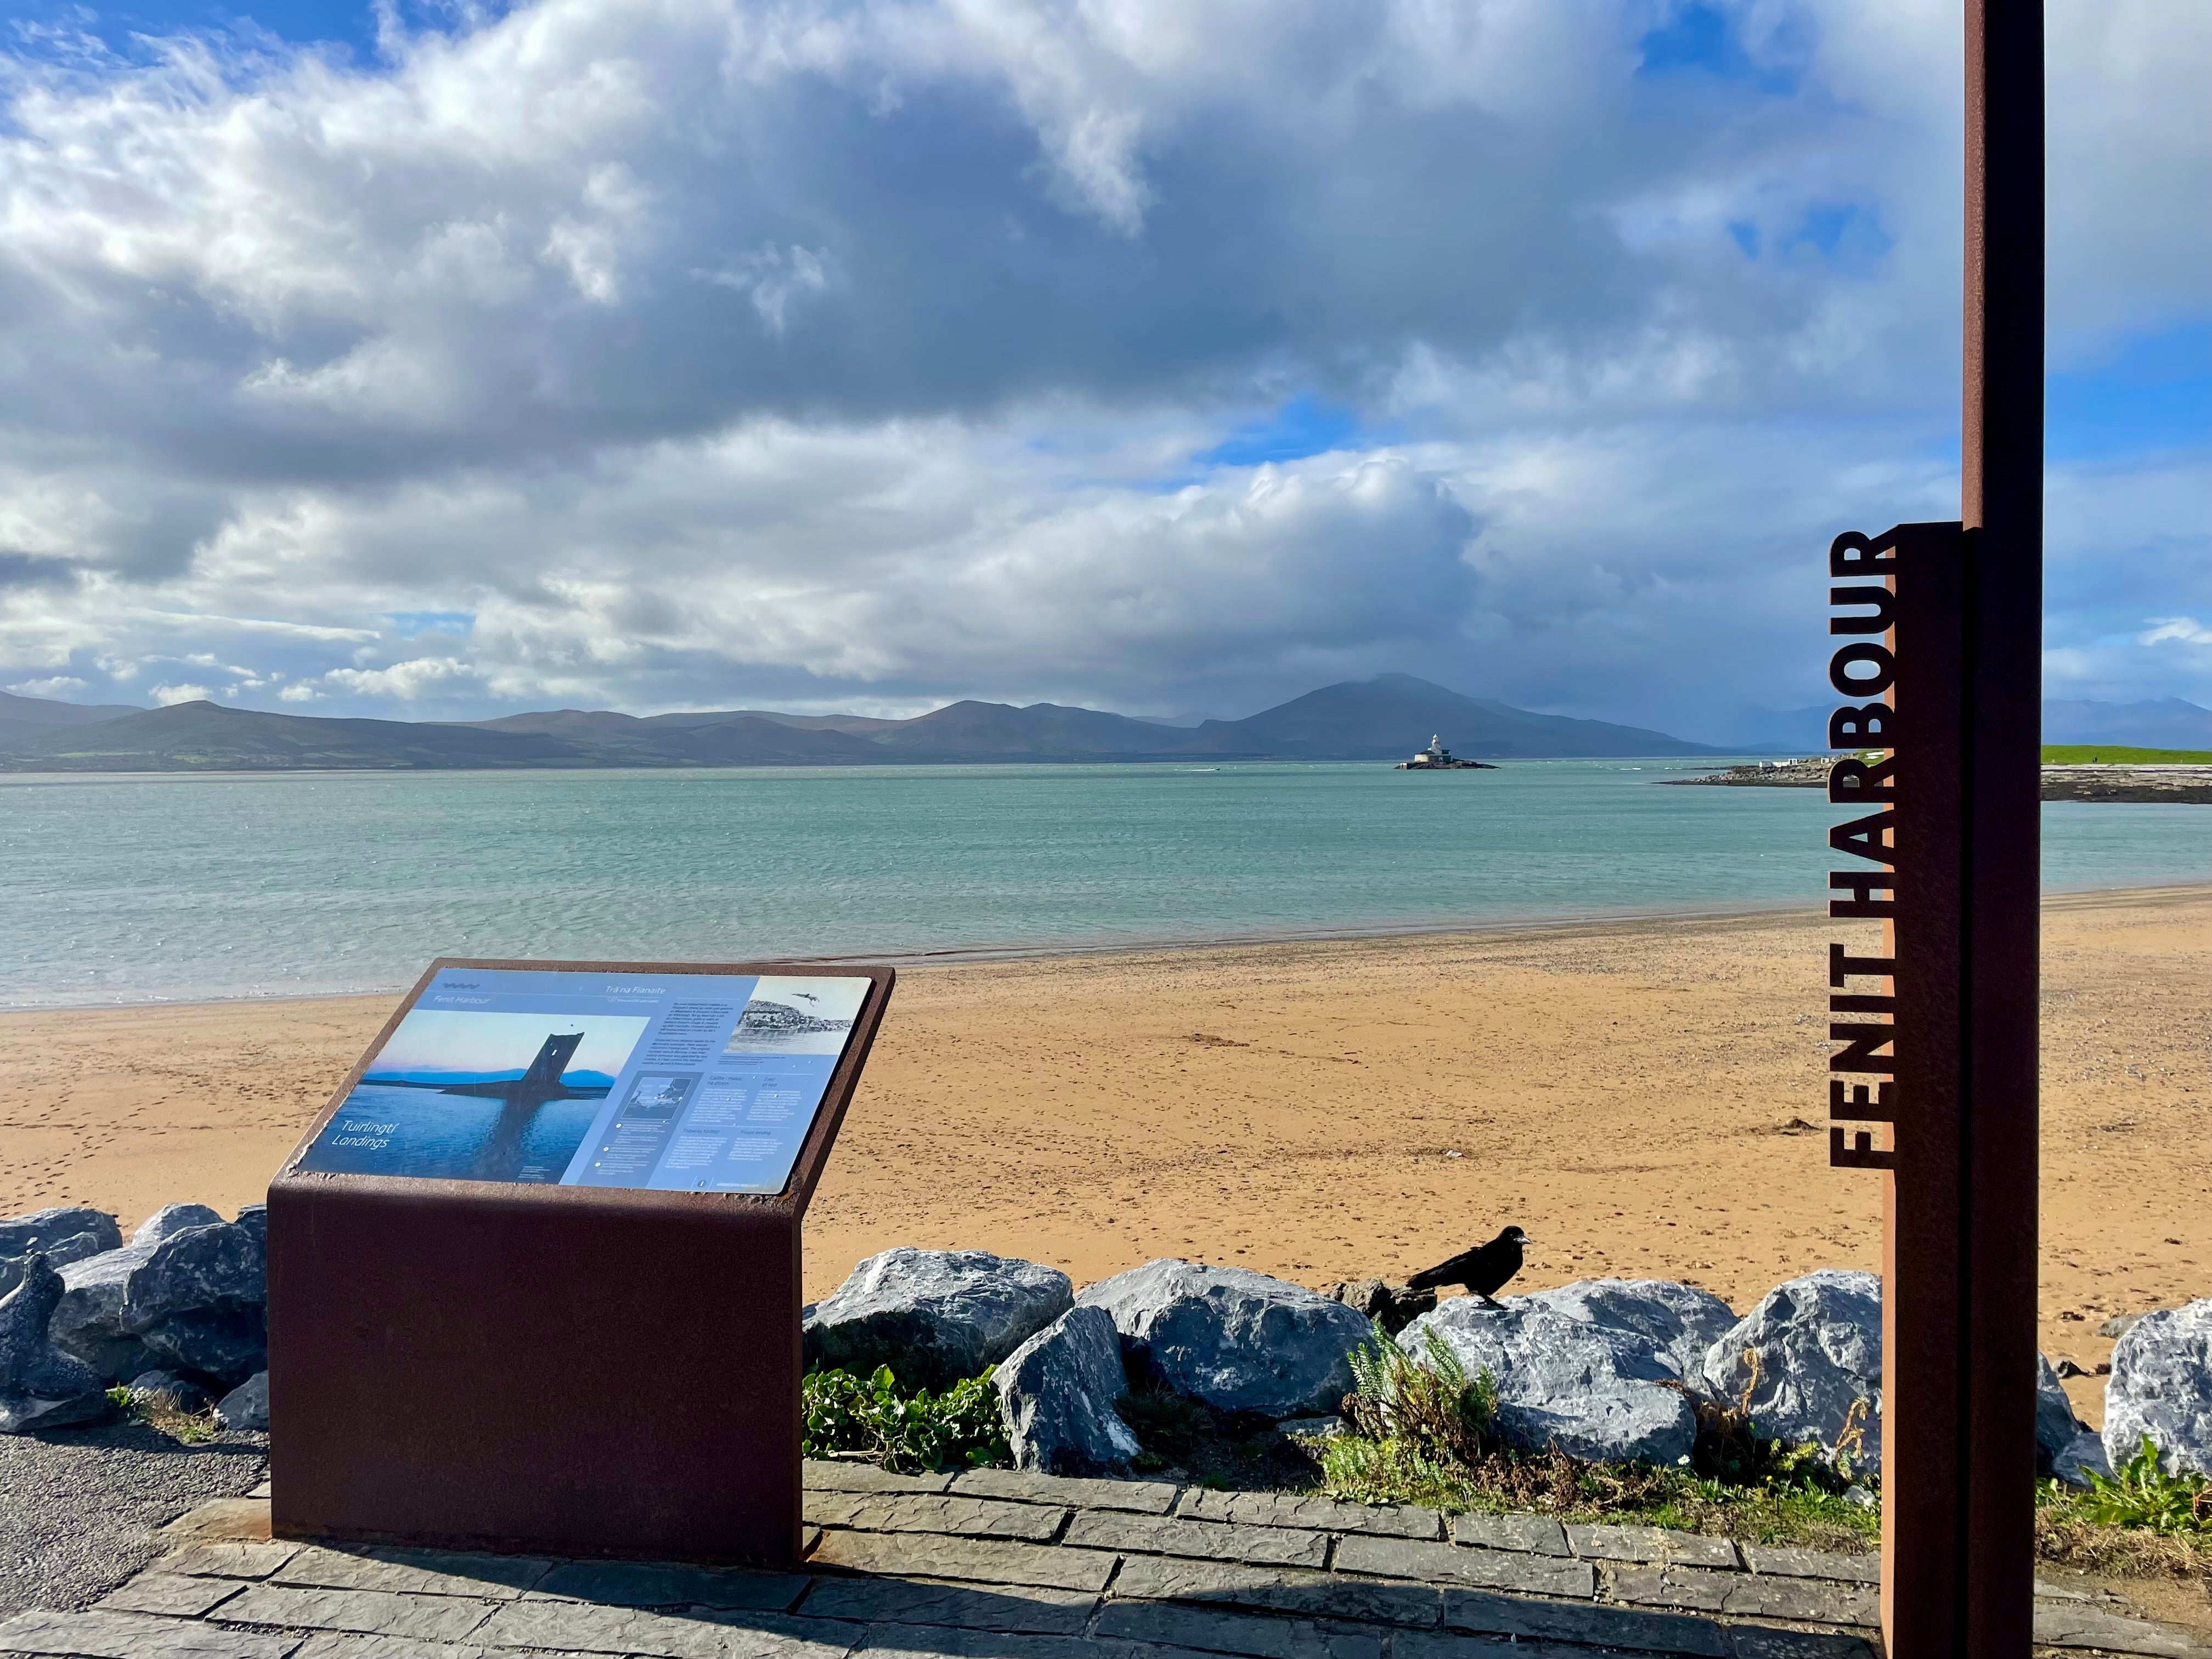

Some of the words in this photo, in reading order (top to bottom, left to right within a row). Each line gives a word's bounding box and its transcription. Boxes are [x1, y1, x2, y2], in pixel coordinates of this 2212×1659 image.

[1829, 529, 1895, 918] HARBOUR
[332, 1134, 390, 1150] Landings
[1830, 944, 1895, 1169] FENIT
